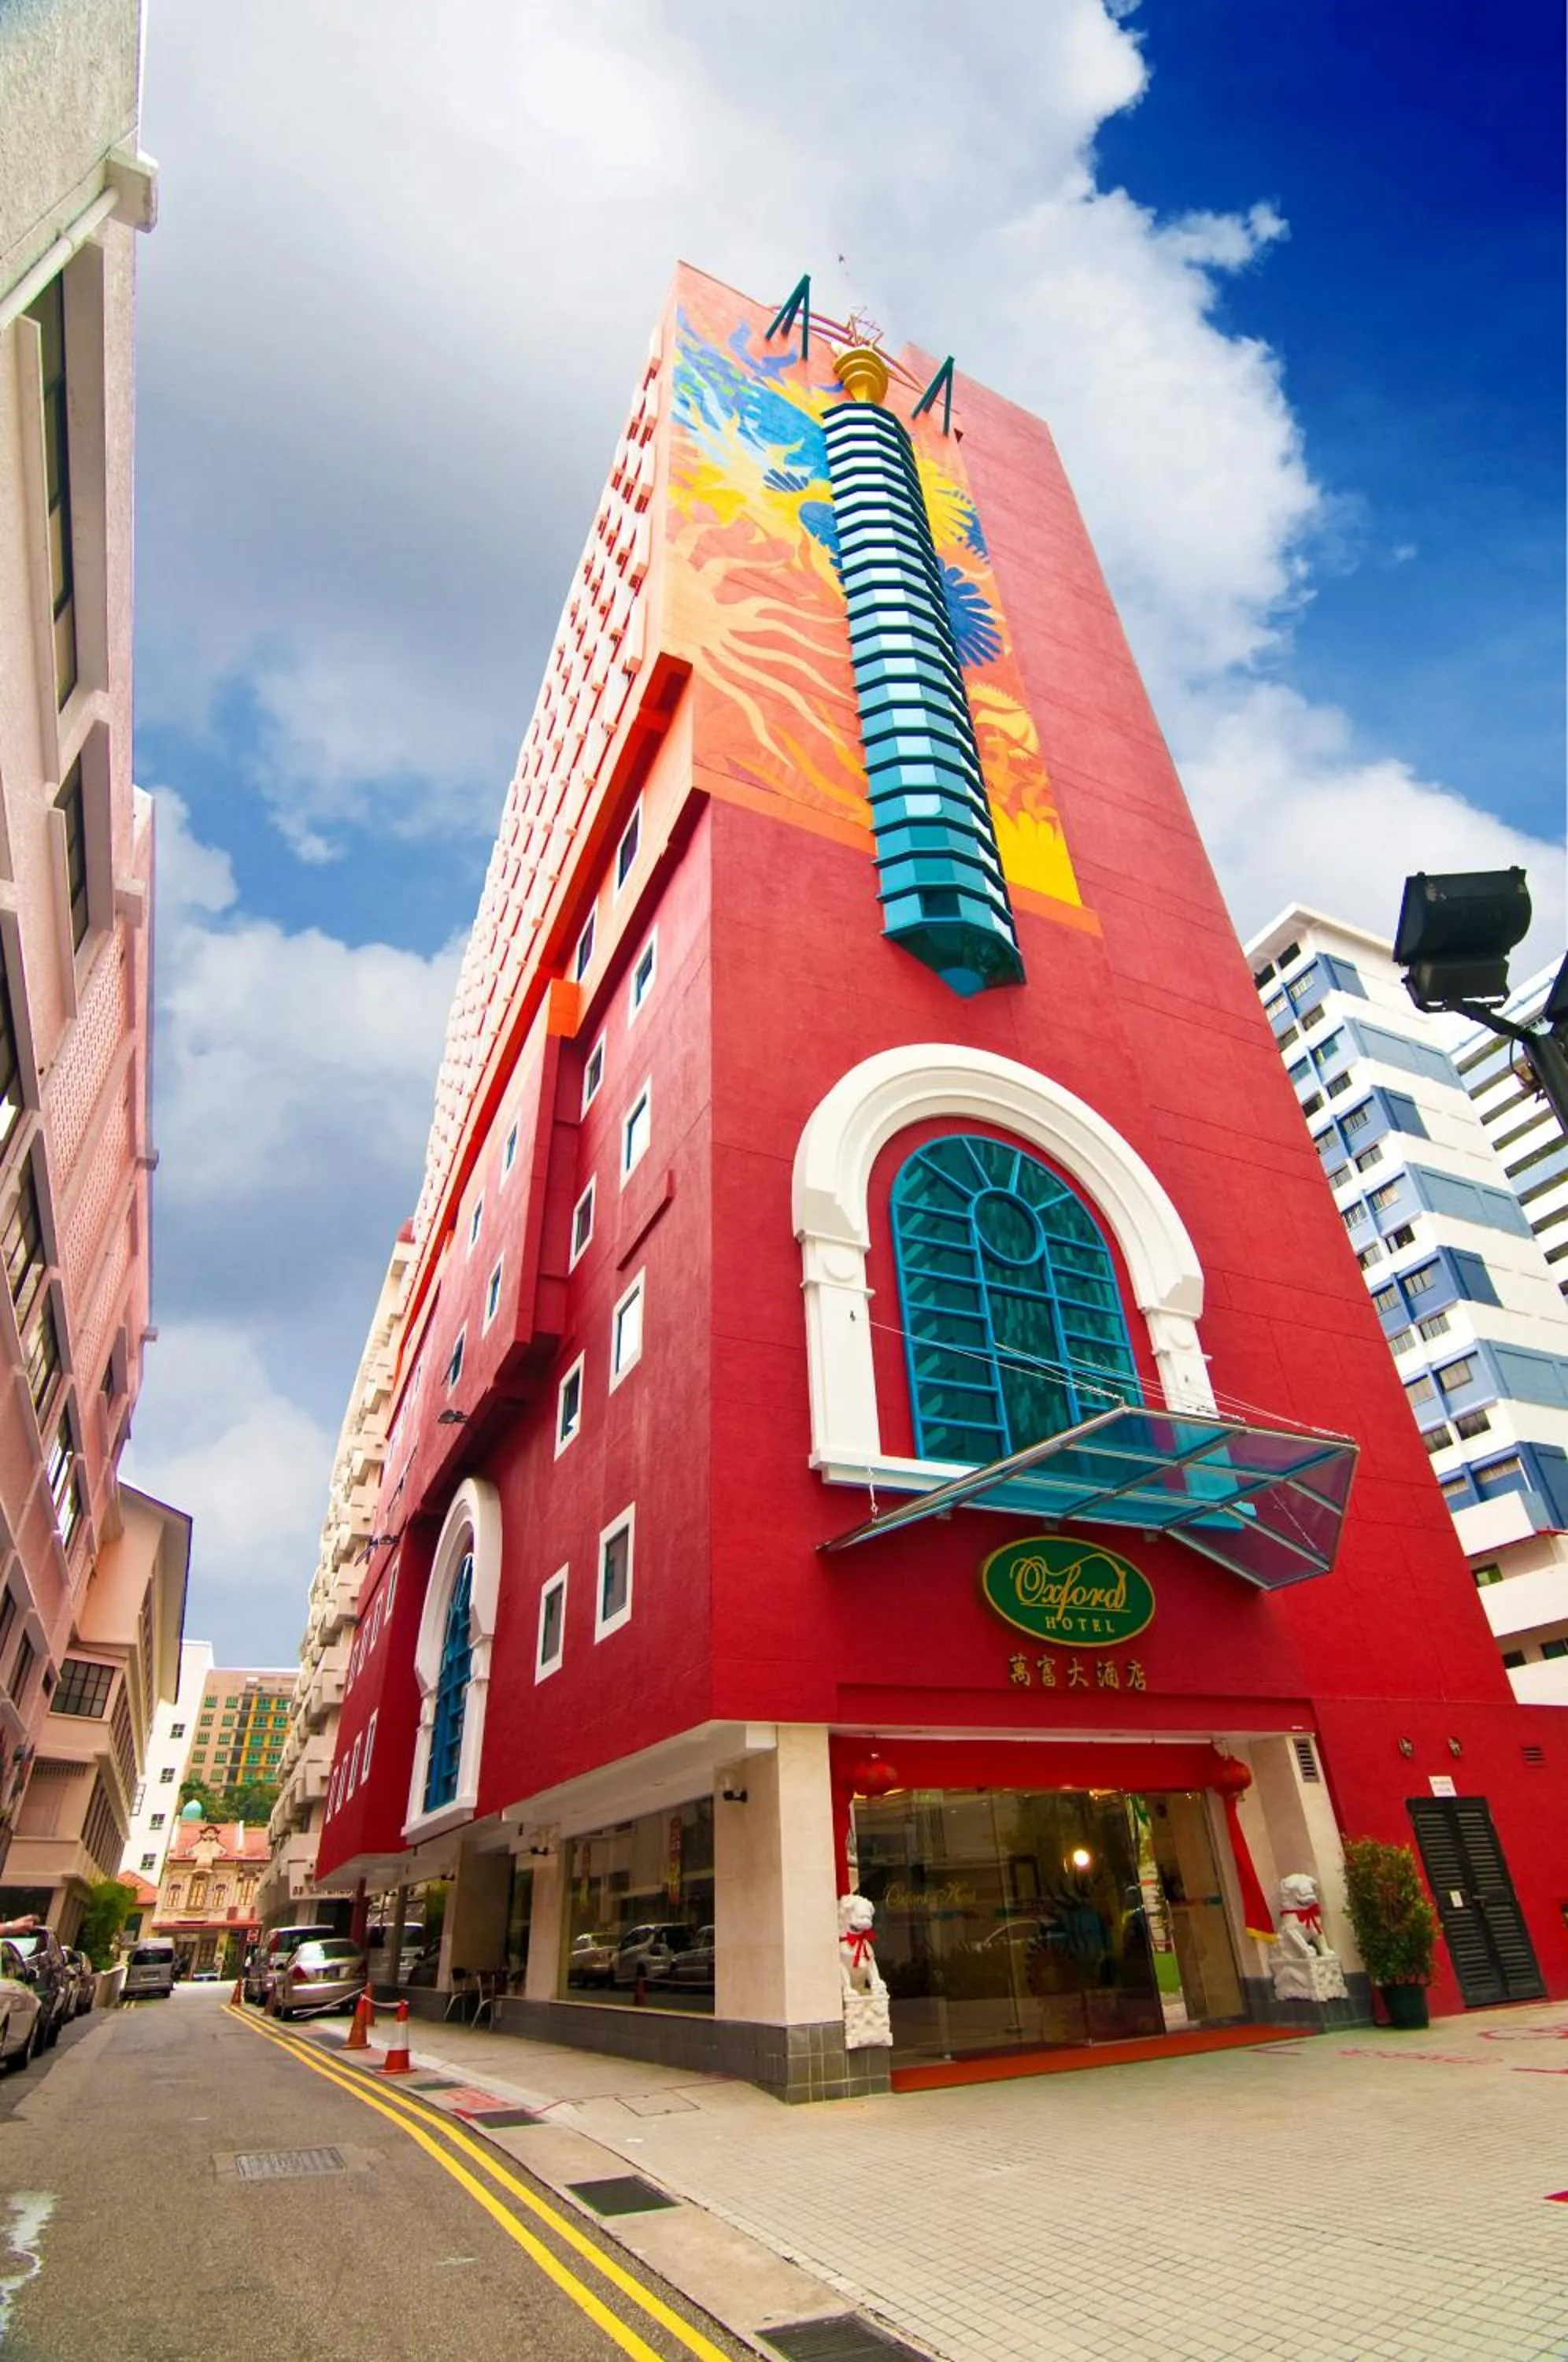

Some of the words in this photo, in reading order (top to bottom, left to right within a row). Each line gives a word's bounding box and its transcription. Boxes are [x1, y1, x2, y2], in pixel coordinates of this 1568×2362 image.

[1010, 1552, 1127, 1620] Oxford
[1045, 1616, 1115, 1633] HOTEL
[1009, 1653, 1147, 1690] 萬富大酒店
